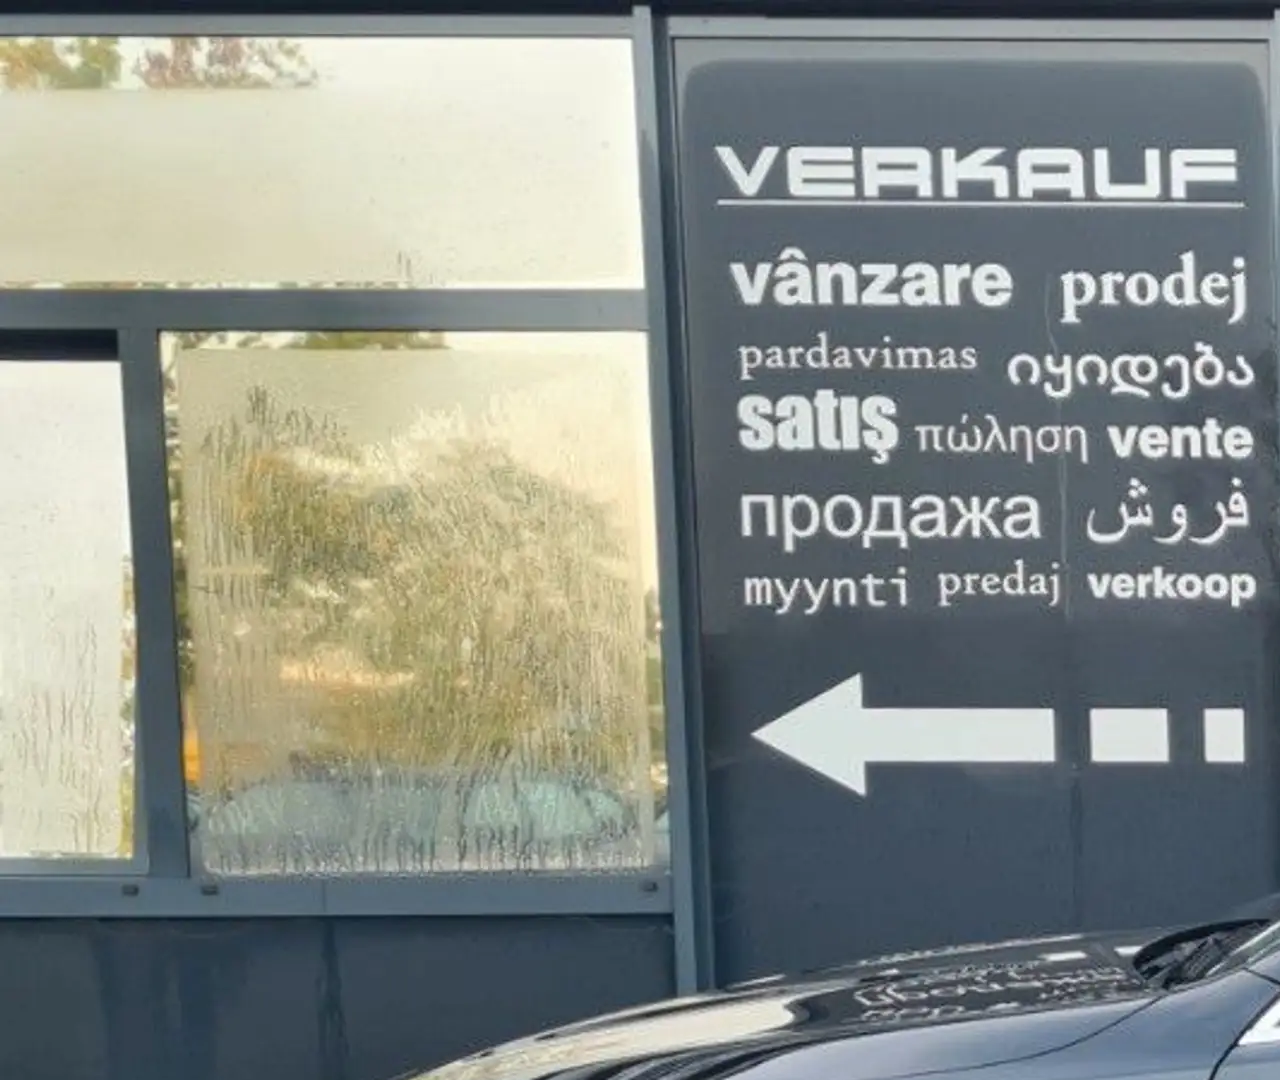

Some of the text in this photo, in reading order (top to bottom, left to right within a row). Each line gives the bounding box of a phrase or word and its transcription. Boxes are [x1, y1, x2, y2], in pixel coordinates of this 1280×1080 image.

[716, 146, 1237, 198] VERKAUF
[730, 247, 1246, 324] vânzare prodej
[738, 331, 1255, 399] pardavimas იყიდება
[738, 389, 1254, 464] satış πώληση vente
[741, 477, 1249, 552] продажа فروش
[744, 559, 1257, 615] myynti predaj verkoop
